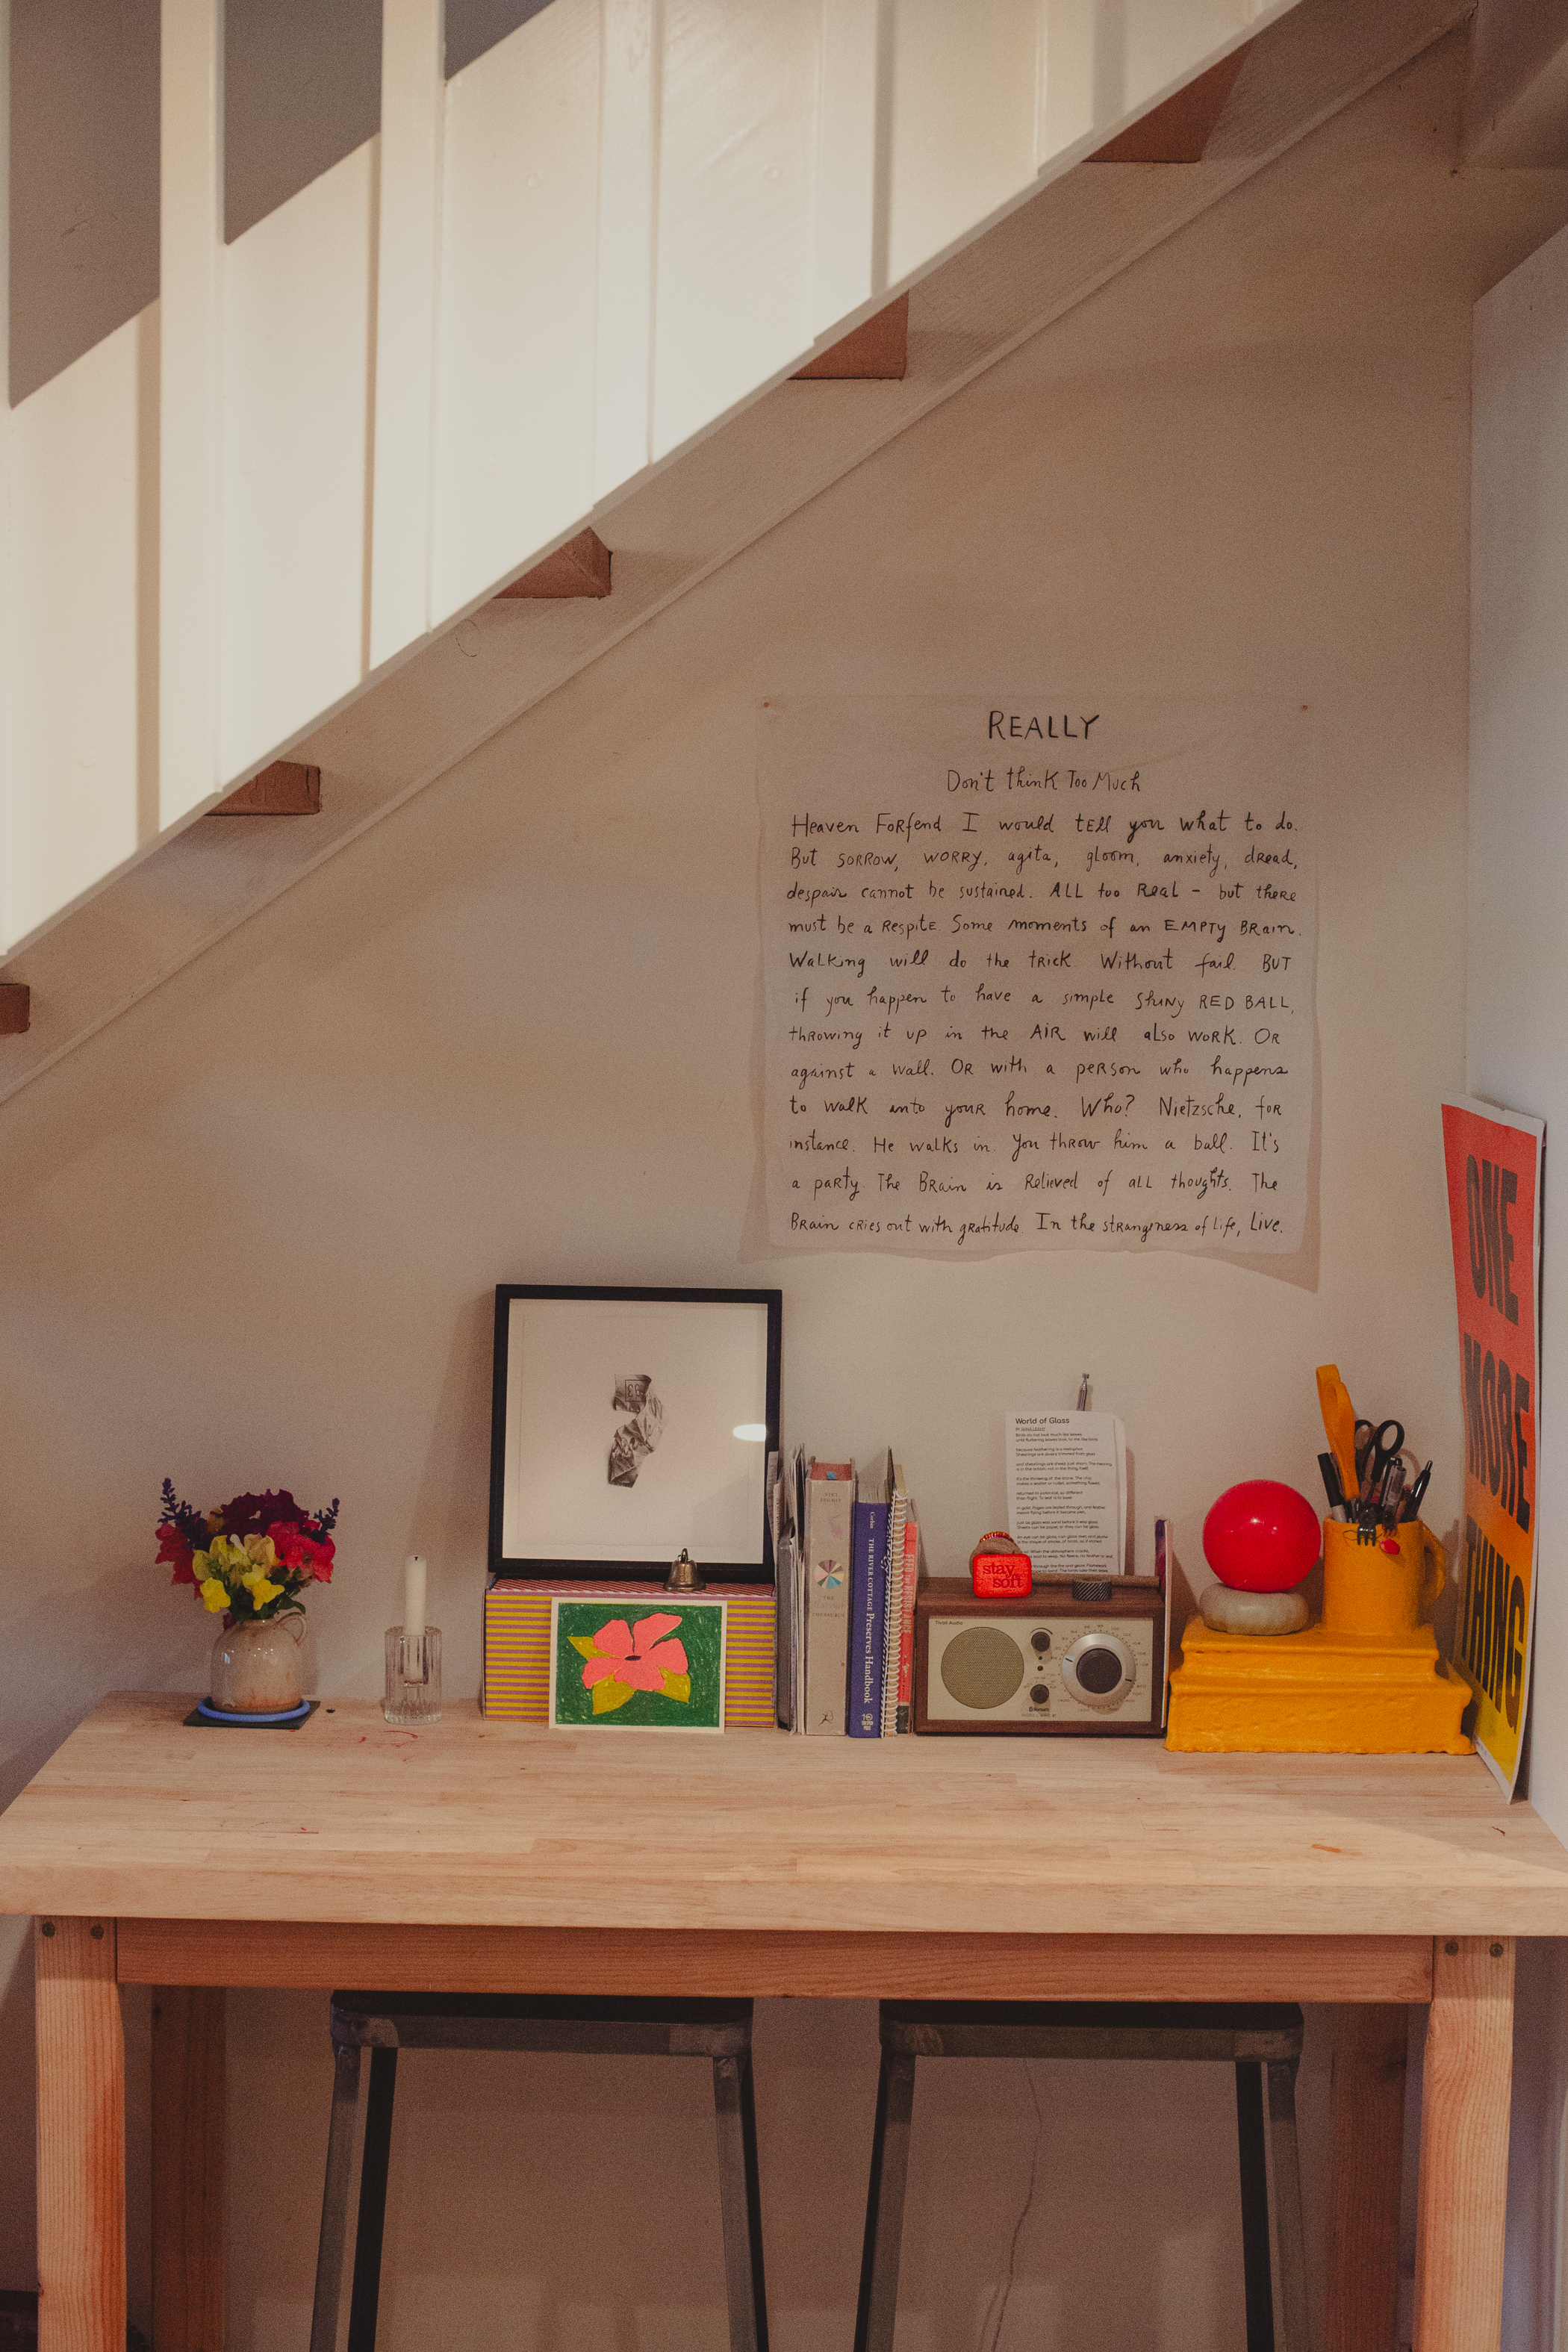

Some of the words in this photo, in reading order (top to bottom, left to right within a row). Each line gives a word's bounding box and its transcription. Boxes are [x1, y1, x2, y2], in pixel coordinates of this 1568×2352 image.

[987, 709, 1101, 741] REALLY
[791, 812, 860, 838] Heaven
[961, 811, 980, 833] I
[998, 812, 1055, 834] would
[1126, 818, 1166, 844] you
[1179, 809, 1232, 833] what
[1243, 811, 1263, 833] to
[1274, 809, 1298, 832] do.
[790, 846, 818, 870] But
[1086, 845, 1140, 873] gloom,
[1163, 843, 1228, 879] anxiety,
[860, 883, 915, 900] cannot
[928, 880, 945, 899] be
[959, 881, 1033, 900] sustained.
[1097, 881, 1121, 899] too
[1219, 882, 1245, 900] but
[788, 912, 827, 933] must
[836, 914, 855, 935] be
[863, 924, 874, 935] a
[1007, 916, 1088, 933] moments
[1100, 915, 1117, 939] of
[1128, 923, 1151, 933] an
[889, 948, 930, 968] will
[948, 948, 967, 968] do
[986, 951, 1010, 969] the
[1100, 947, 1174, 971] Without
[1262, 953, 1292, 974] BUT
[794, 986, 810, 1013] if
[824, 995, 854, 1018] you
[866, 985, 927, 1015] happen
[940, 984, 956, 1004] to
[974, 982, 1012, 1003] have
[1030, 993, 1044, 1004] a
[1062, 988, 1115, 1011] simple
[1198, 994, 1235, 1011] RED
[1245, 994, 1295, 1015] BALL,
[877, 1021, 892, 1039] it
[906, 1028, 927, 1045] up
[944, 1025, 963, 1041] in
[980, 1024, 1009, 1041] the
[1083, 1025, 1118, 1042] will
[790, 1061, 856, 1091] against
[868, 1068, 877, 1077] a
[892, 1058, 934, 1077] wall.
[989, 1054, 1027, 1074] with
[1045, 1063, 1056, 1075] a
[1159, 1057, 1189, 1076] who
[788, 1095, 807, 1116] to
[1004, 1089, 1058, 1119] home.
[1080, 1091, 1136, 1119] Who?
[1159, 1092, 1242, 1119] Nietzsche,
[789, 1128, 856, 1152] instance.
[873, 1136, 895, 1154] He
[1113, 1127, 1148, 1151] him
[1164, 1139, 1176, 1151] a
[1193, 1131, 1233, 1154] ball.
[1251, 1130, 1280, 1154] It's
[791, 1179, 801, 1189] a
[877, 1172, 900, 1192] The
[986, 1180, 1004, 1192] is
[1097, 1169, 1114, 1197] of
[1170, 1166, 1231, 1201] thoughts.
[1251, 1171, 1278, 1193] The
[886, 1213, 912, 1233] out
[918, 1214, 953, 1233] with
[1035, 1211, 1062, 1231] In
[1070, 1211, 1096, 1233] the
[1194, 1214, 1210, 1236] of
[1466, 1154, 1519, 1327] ONE
[1039, 1416, 1048, 1425] of
[1463, 1331, 1530, 1534] MORE
[903, 1554, 915, 1572] FEED
[983, 1562, 1015, 1578] stay
[992, 1574, 1024, 1589] soft
[900, 1585, 915, 1634] RESISTANCE
[1461, 1513, 1525, 1735] THING
[865, 1613, 875, 1654] Preserves
[863, 1655, 874, 1704] Handbook
